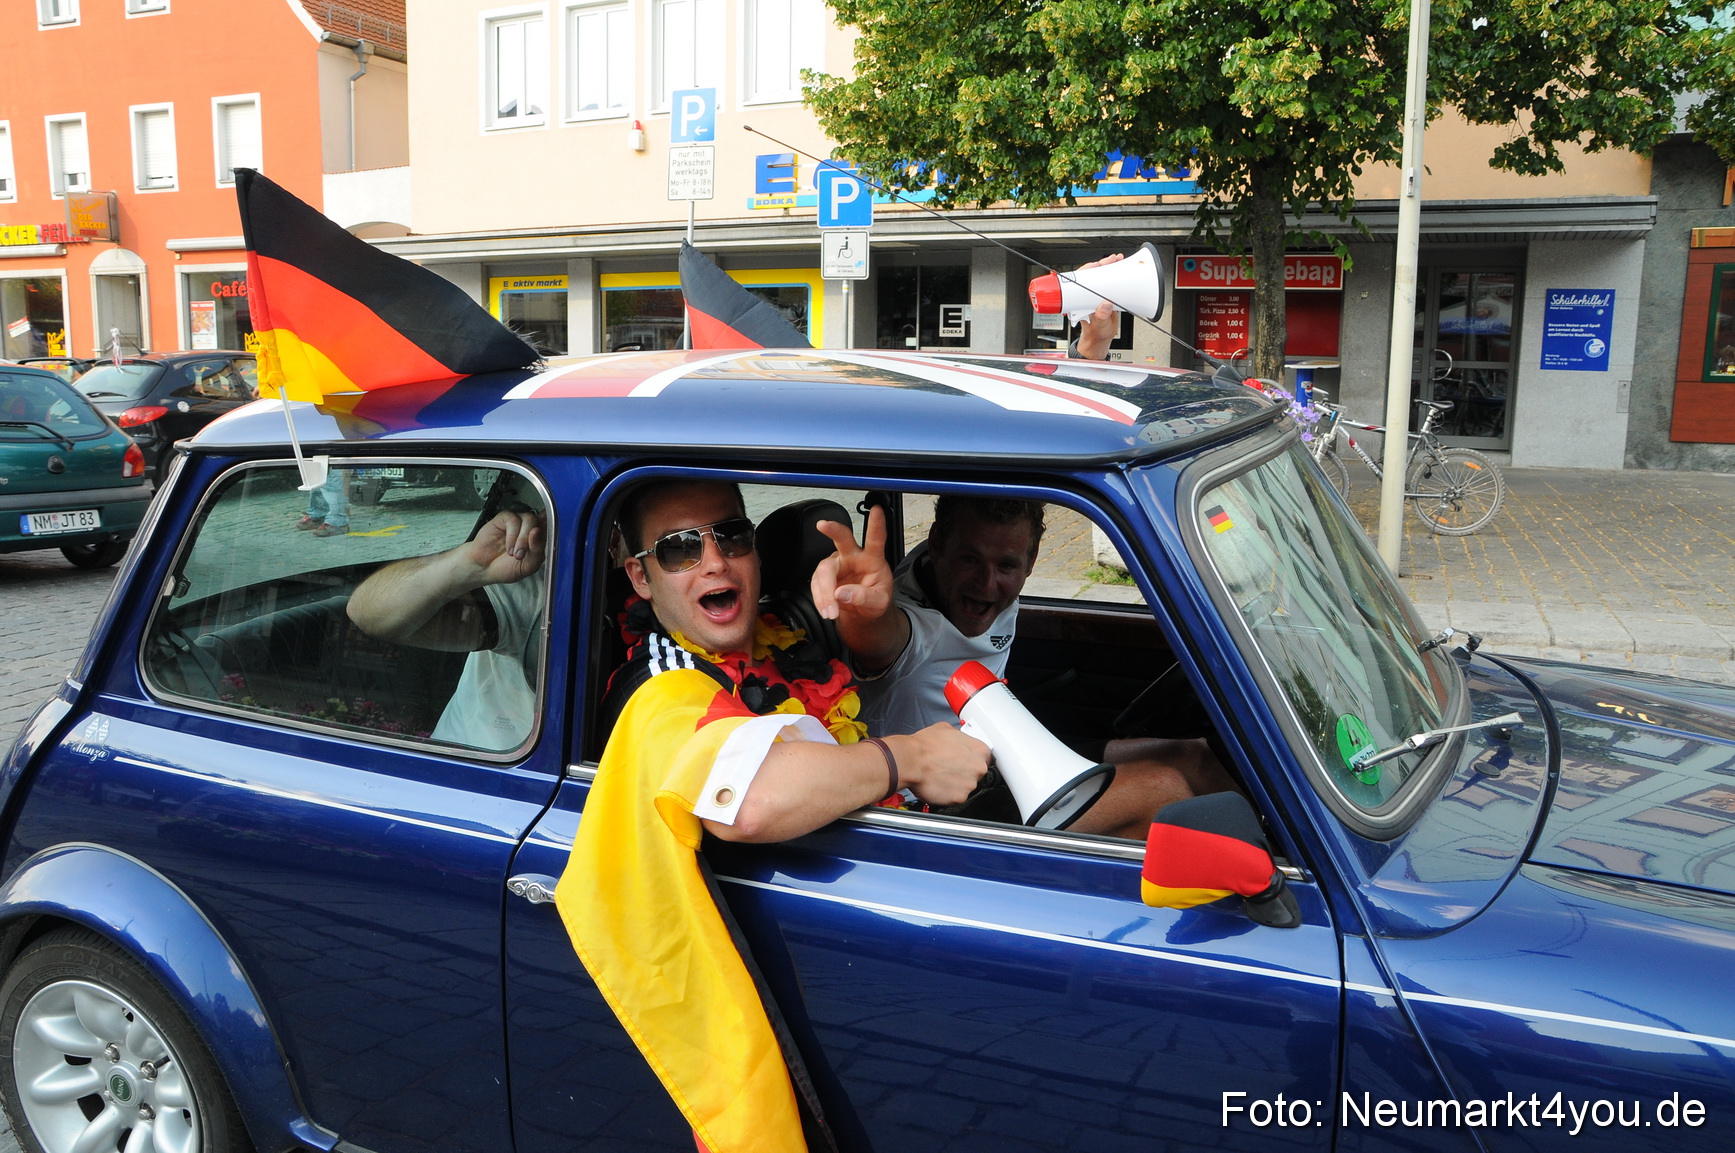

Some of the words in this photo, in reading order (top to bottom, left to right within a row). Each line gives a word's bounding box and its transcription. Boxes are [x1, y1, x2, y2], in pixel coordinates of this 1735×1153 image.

[681, 95, 706, 137] P
[693, 150, 705, 158] mit
[672, 159, 711, 167] Parkschein
[675, 168, 708, 177] werktags
[670, 188, 679, 196] Sa
[755, 197, 794, 206] EDEKA
[830, 177, 860, 220] P
[1200, 259, 1255, 286] Supe
[1284, 259, 1336, 286] ebap
[513, 279, 535, 288] aktiv
[536, 279, 563, 287] markt
[210, 281, 248, 298] Café
[1199, 319, 1219, 327] Börek
[1198, 331, 1220, 339] Getränk
[1226, 332, 1239, 340] 1,00
[33, 514, 53, 530] NM
[61, 513, 76, 527] JT
[80, 511, 94, 526] 83
[72, 741, 108, 762] Monza
